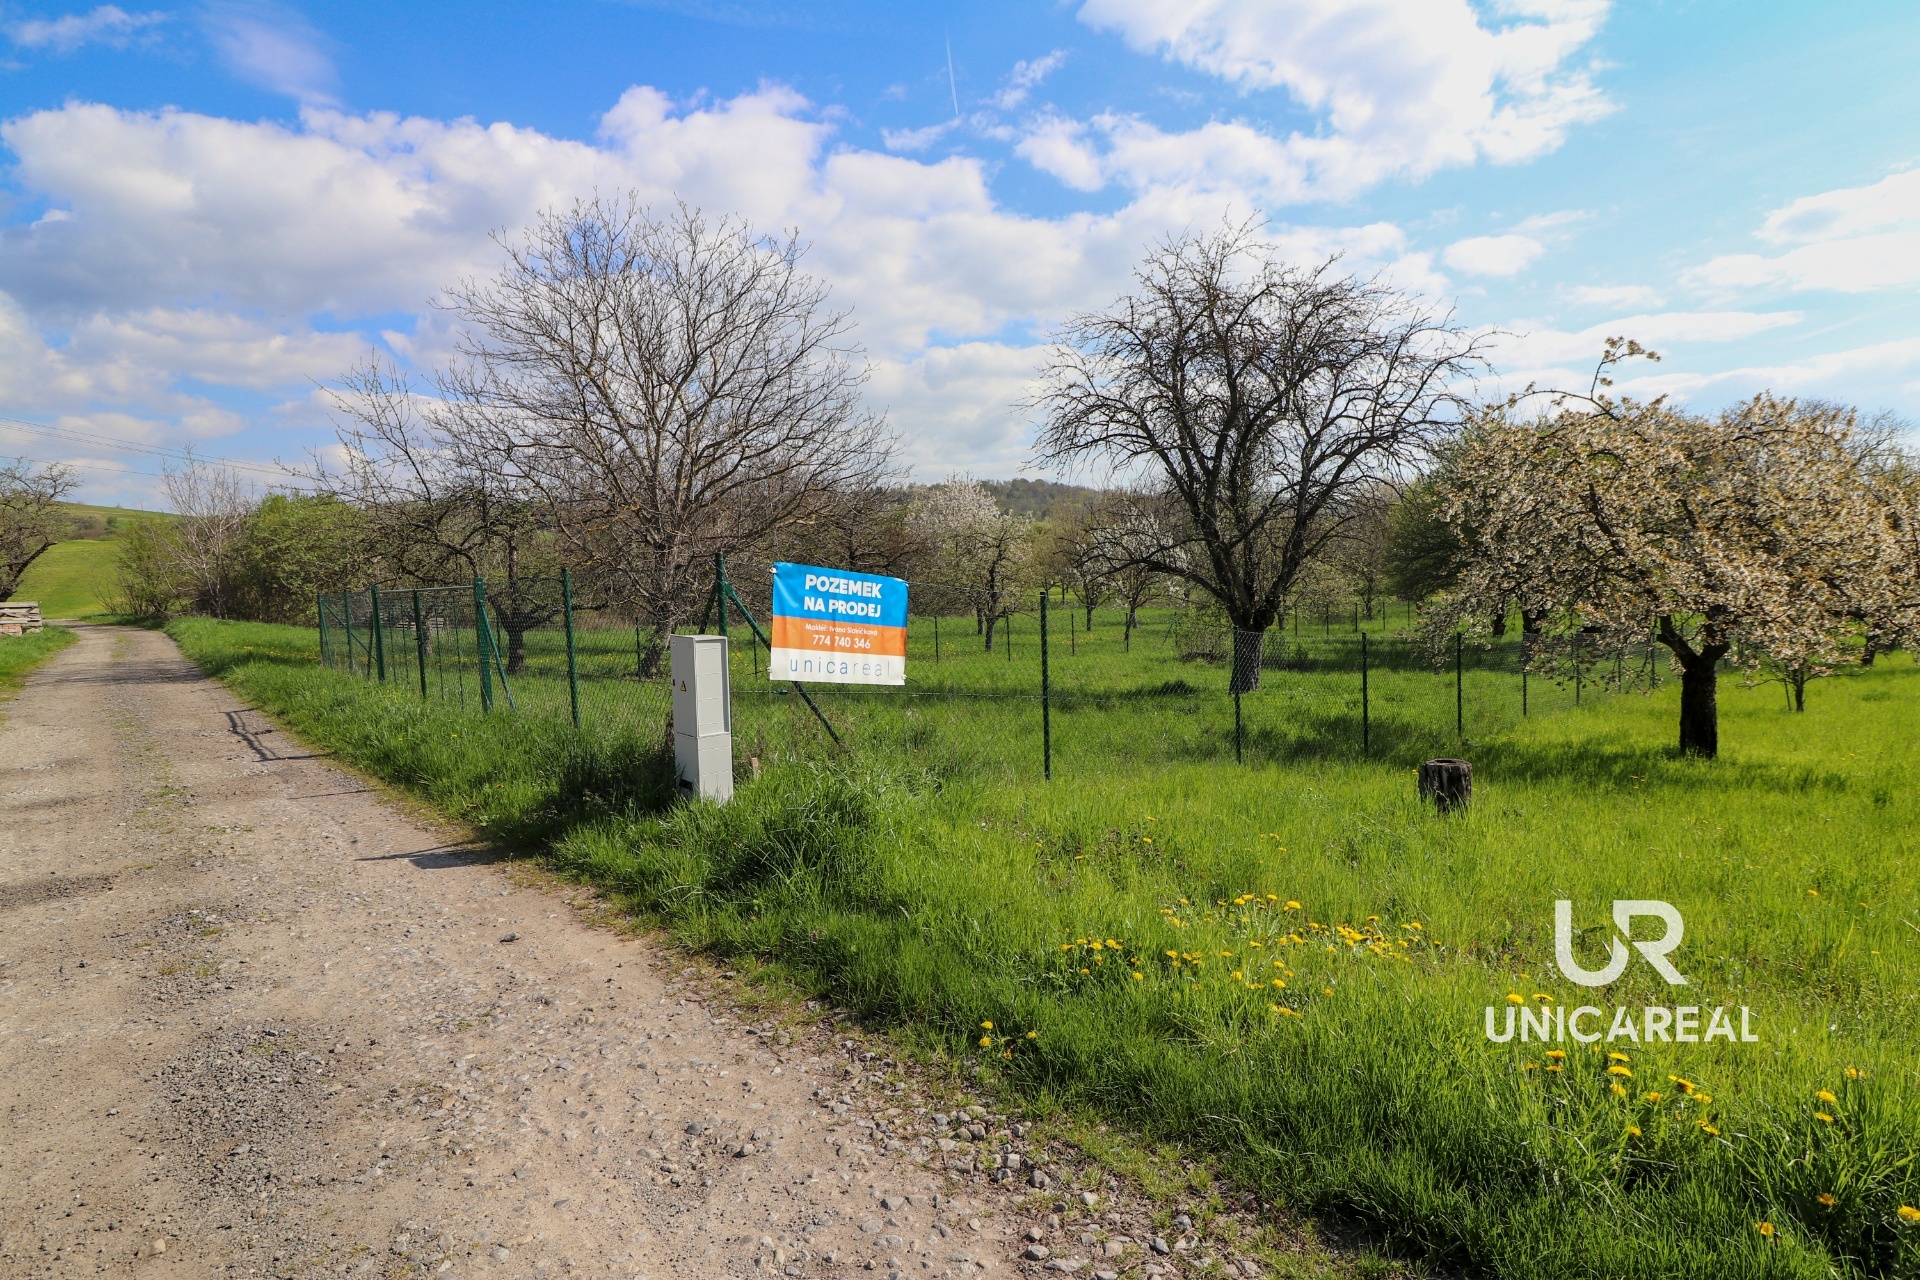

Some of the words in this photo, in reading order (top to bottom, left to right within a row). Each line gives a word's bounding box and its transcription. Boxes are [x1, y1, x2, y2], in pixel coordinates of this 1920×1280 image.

[805, 574, 883, 599] POZEMEK
[803, 596, 825, 612] NA
[828, 599, 881, 618] PRODEJ
[829, 626, 846, 634] Ivana
[812, 634, 831, 646] 774
[834, 636, 851, 648] 740
[853, 637, 871, 649] 346
[790, 656, 890, 677] unicareal
